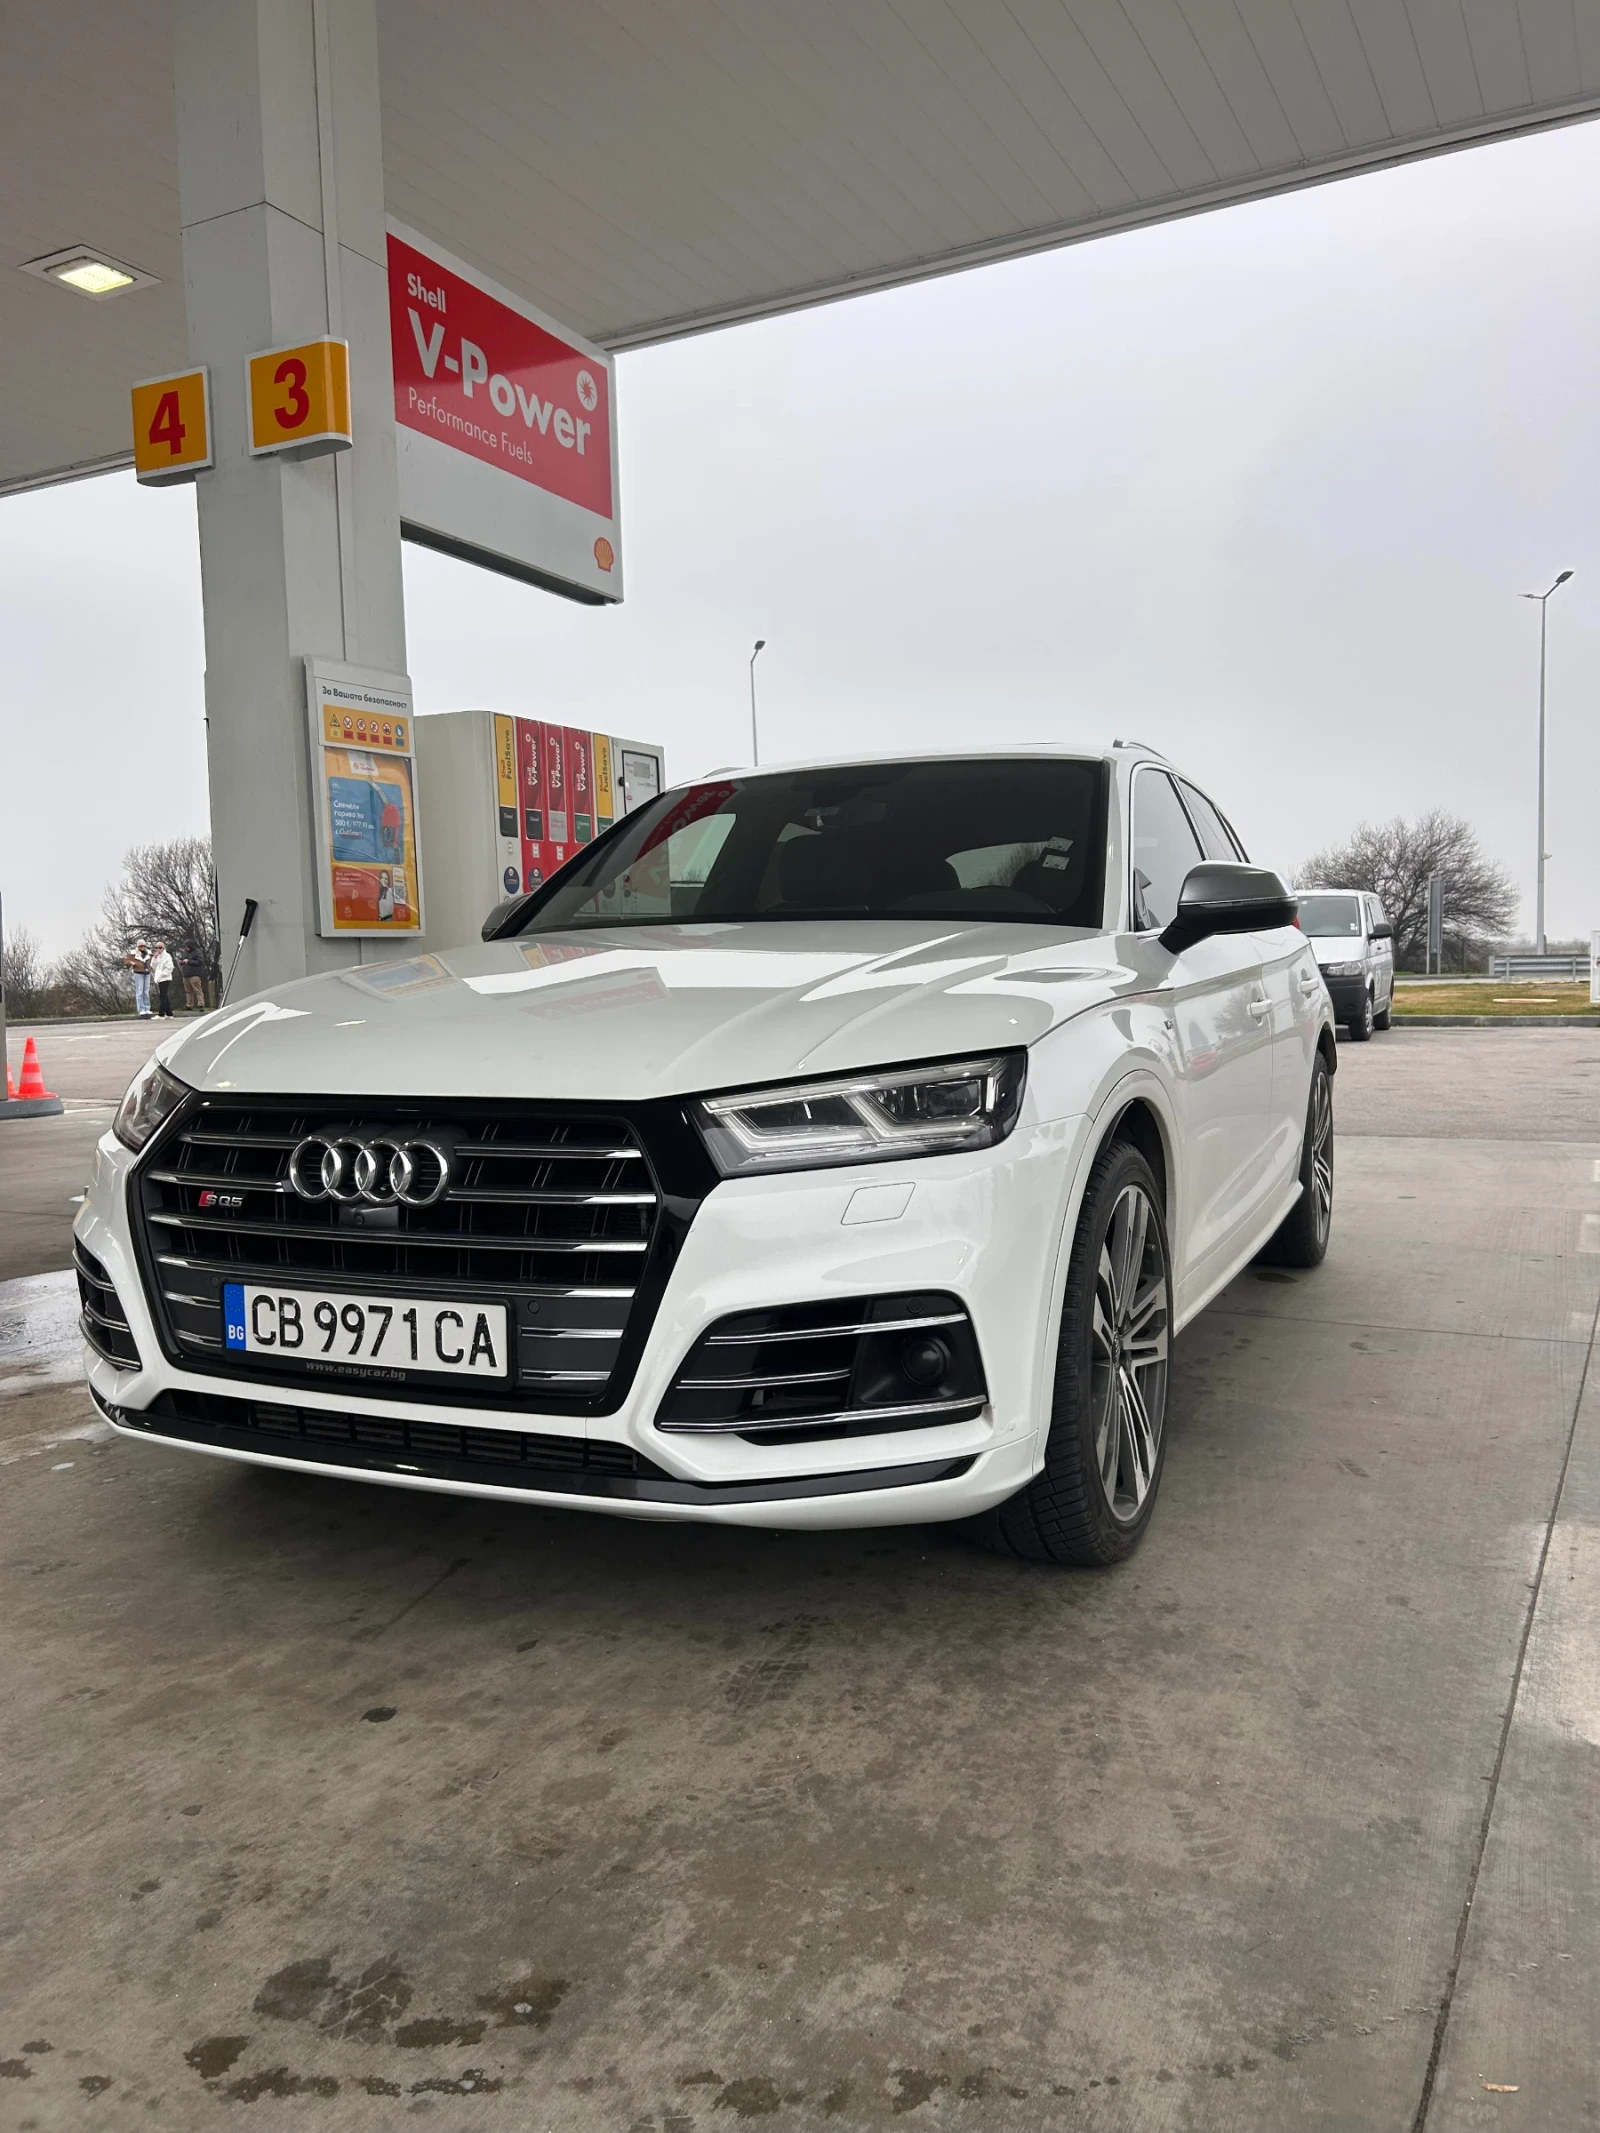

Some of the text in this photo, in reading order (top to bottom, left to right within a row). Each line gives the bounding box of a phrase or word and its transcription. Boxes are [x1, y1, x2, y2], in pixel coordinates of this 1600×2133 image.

[407, 272, 447, 313] Shell
[273, 358, 310, 429] 3
[407, 306, 591, 456] V-Power
[148, 390, 186, 455] 4
[408, 386, 533, 465] Performance Fuels
[322, 685, 408, 709] За Вашата безопасност
[504, 729, 512, 780] FuelSave
[205, 1193, 244, 1208] SQ5
[228, 1324, 245, 1341] BG
[305, 1360, 407, 1381] www.easycar.bg
